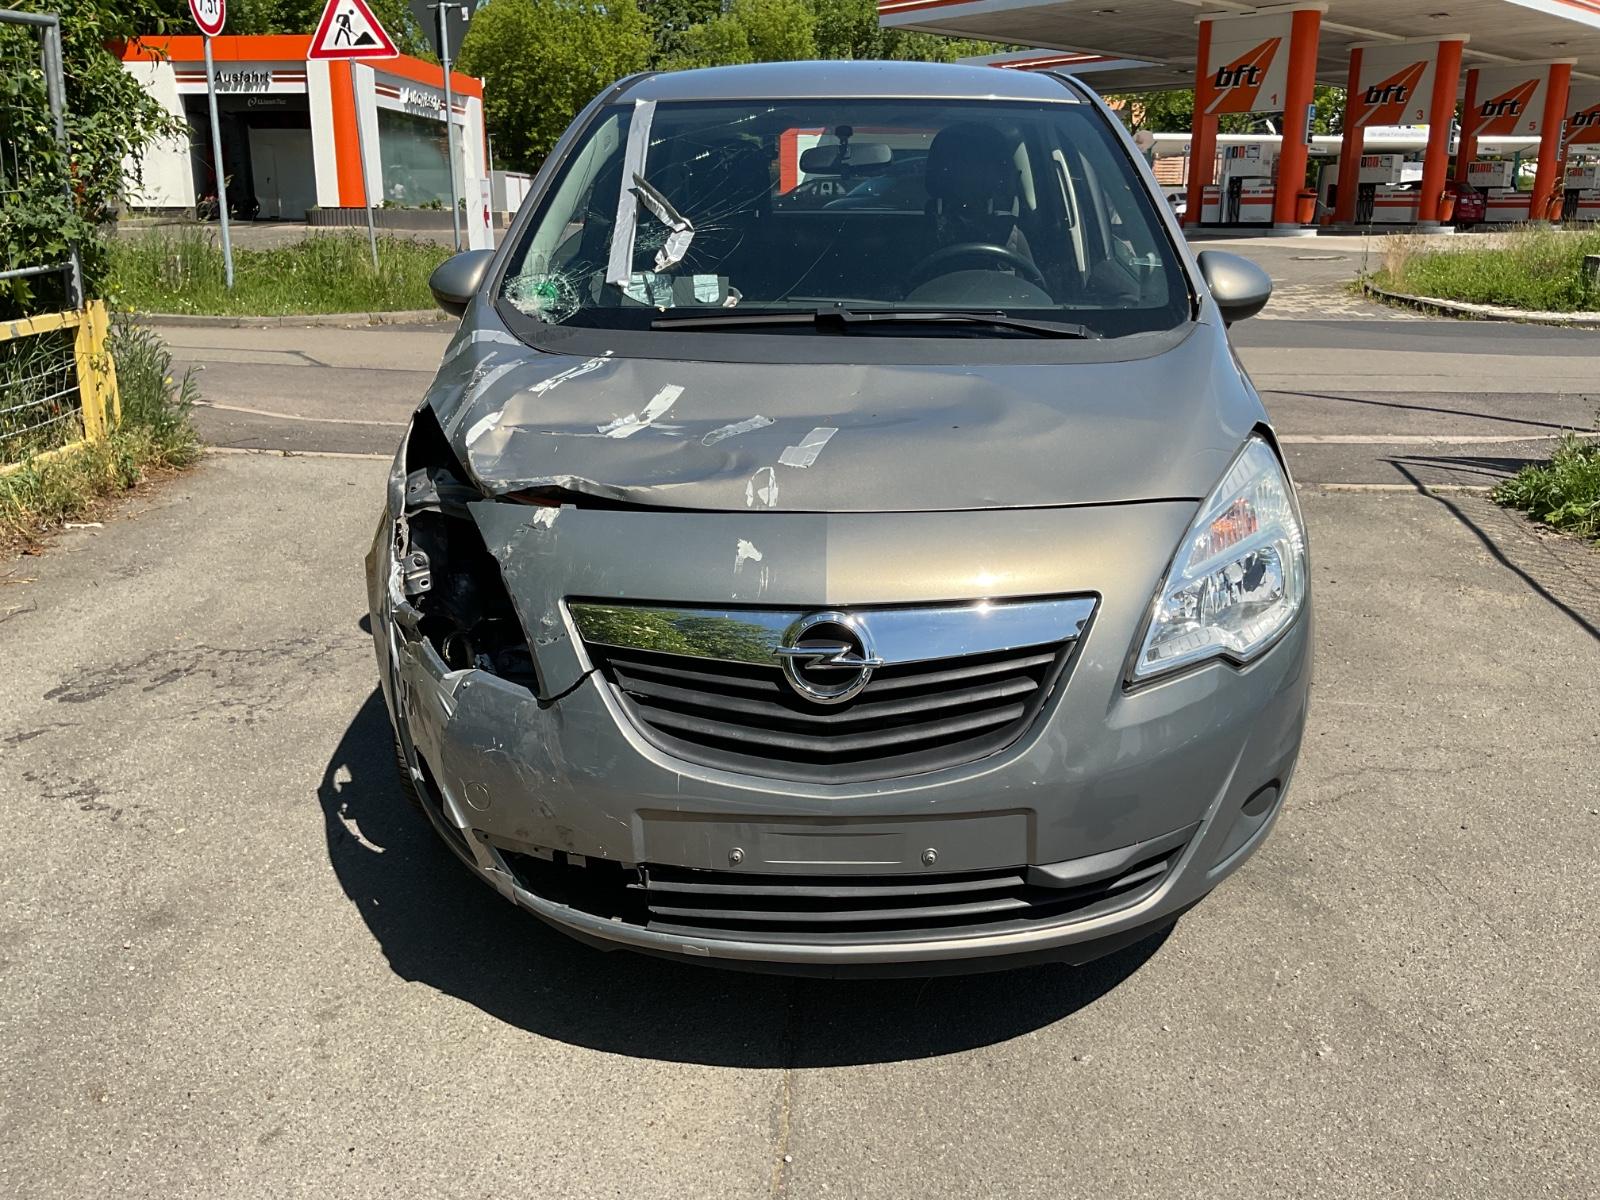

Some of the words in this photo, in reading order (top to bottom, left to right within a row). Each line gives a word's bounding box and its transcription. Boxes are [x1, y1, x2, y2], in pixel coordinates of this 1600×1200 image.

[214, 70, 270, 83] Ausfahrt
[1214, 64, 1261, 88] bft
[1270, 94, 1278, 106] 1
[1364, 84, 1407, 105] bft
[1416, 109, 1424, 121] 3
[1480, 98, 1521, 118] bft
[1571, 111, 1600, 127] bf
[1529, 122, 1537, 132] 5
